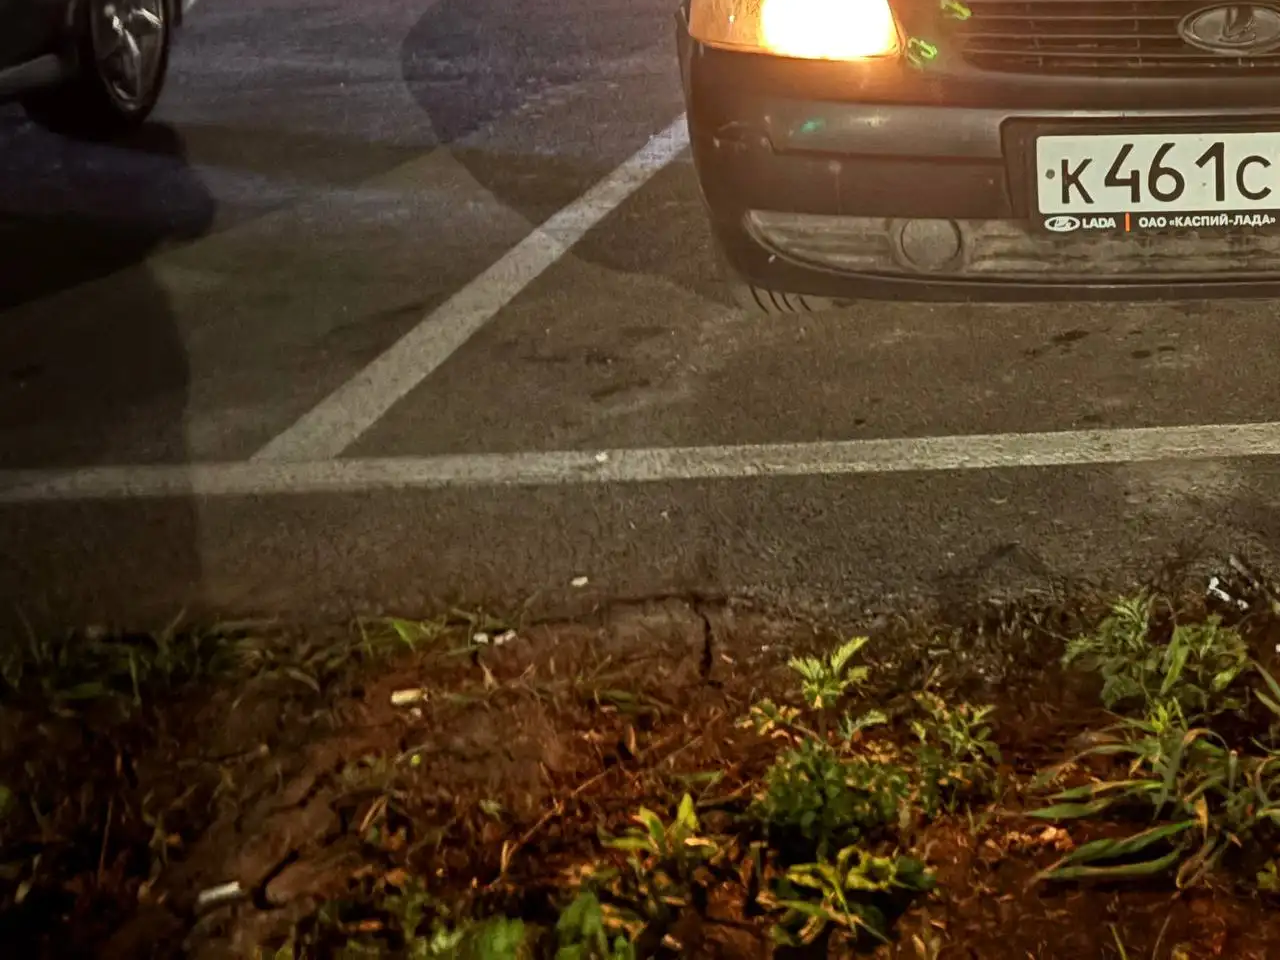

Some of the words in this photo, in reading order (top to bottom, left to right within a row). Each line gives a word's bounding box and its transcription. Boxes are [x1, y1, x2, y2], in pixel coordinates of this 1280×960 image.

[1082, 218, 1117, 230] LADA
[1138, 217, 1168, 228] ОАО
[1169, 213, 1276, 228] «КАСПИЙ-ЛАДА»
